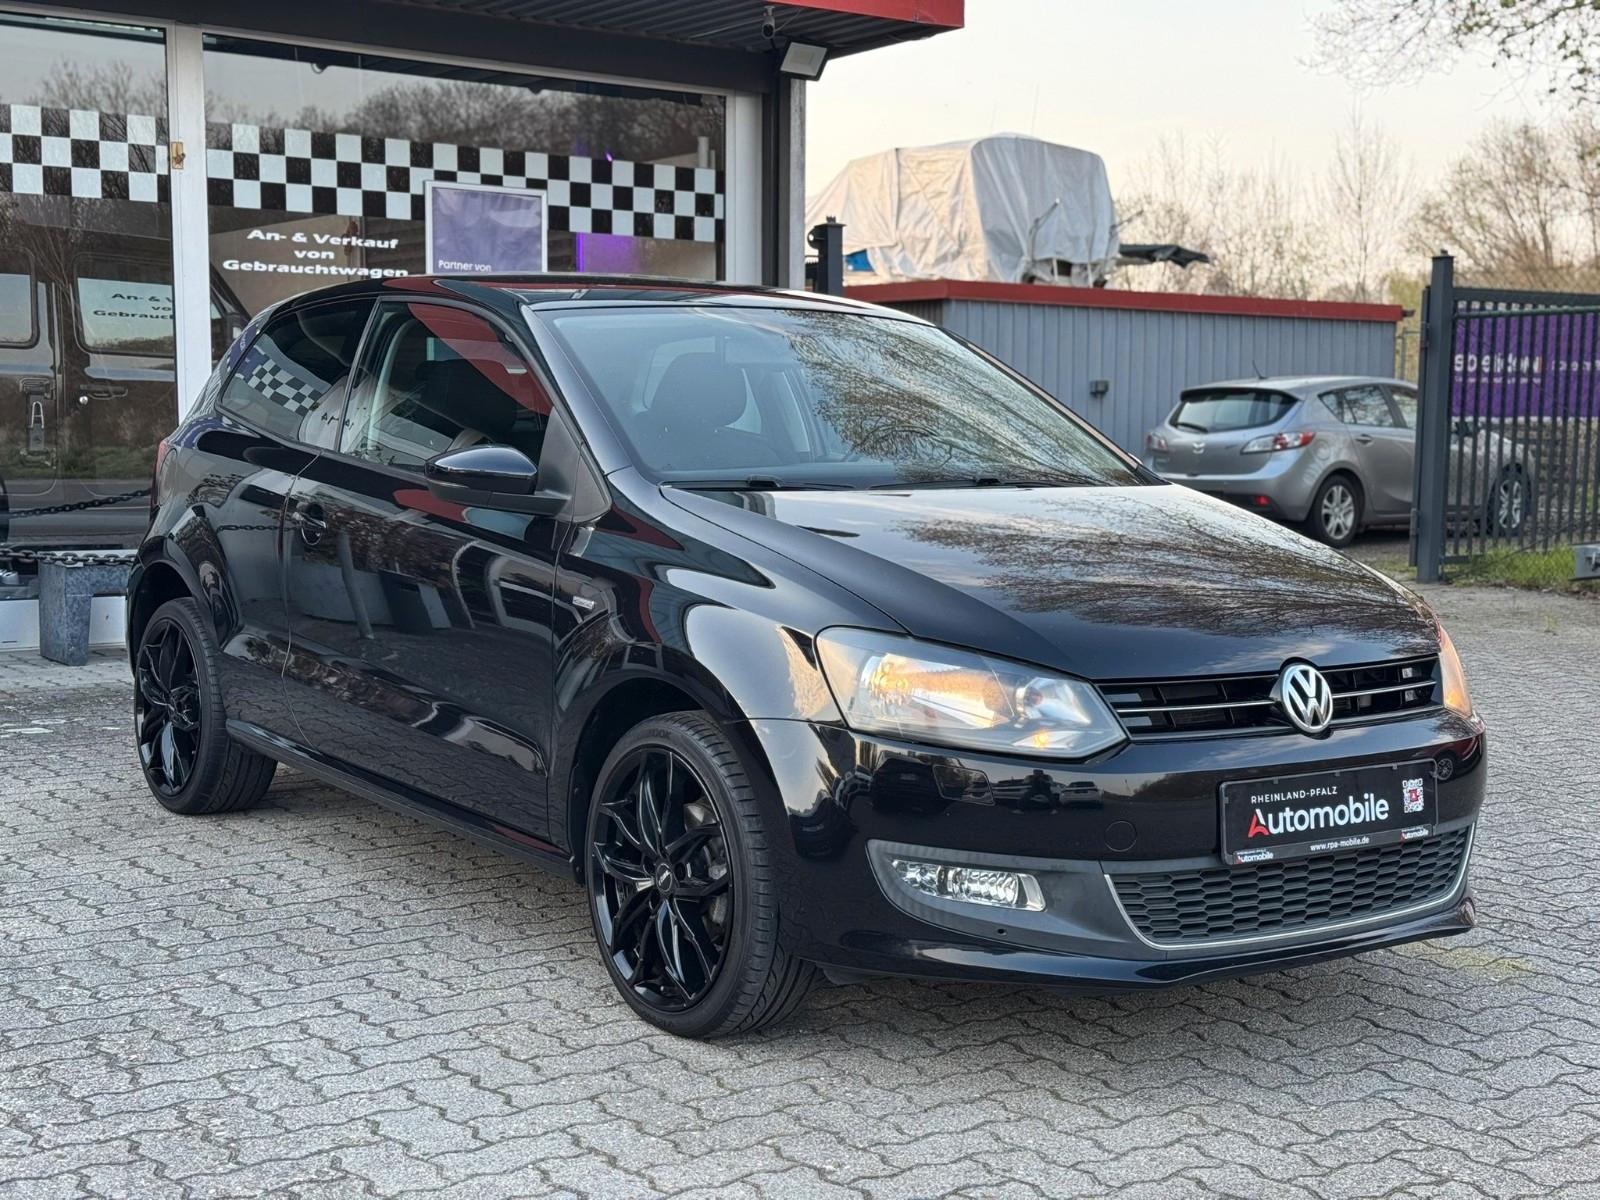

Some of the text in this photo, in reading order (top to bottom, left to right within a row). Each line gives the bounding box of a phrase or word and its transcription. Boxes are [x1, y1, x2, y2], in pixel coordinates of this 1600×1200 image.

[247, 229, 399, 249] An- & Verkauf
[294, 250, 335, 259] von
[222, 259, 409, 278] Gebrauchtwagen
[438, 259, 492, 272] Partner von
[1251, 786, 1338, 804] RHEINLAND-PFALZ
[1248, 793, 1389, 838] Automobile
[1310, 836, 1370, 851] www.rpa-mobile.de
